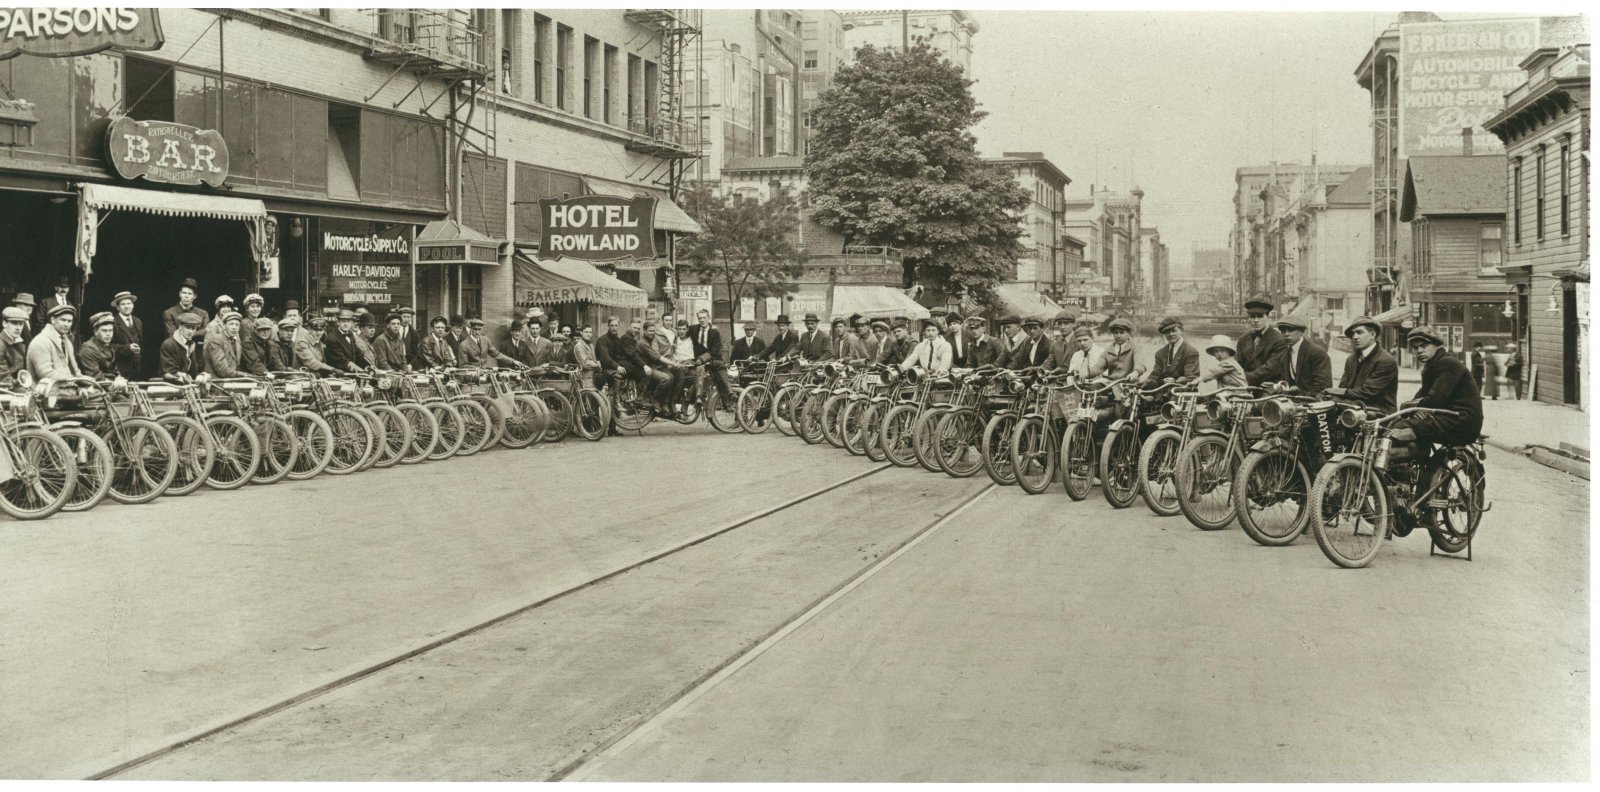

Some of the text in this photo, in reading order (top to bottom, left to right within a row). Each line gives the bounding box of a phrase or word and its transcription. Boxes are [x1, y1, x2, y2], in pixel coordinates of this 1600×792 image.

[1411, 75, 1481, 90] BICYCLE
[1404, 92, 1456, 108] MOTOR
[123, 134, 221, 173] BAR
[549, 205, 639, 228] HOTEL
[550, 234, 640, 251] ROWLAND
[421, 247, 462, 260] POOL
[333, 264, 401, 278] HARLEY-DAVIDSON
[526, 288, 581, 302] BAKERY
[1317, 413, 1332, 453] DAYTON
